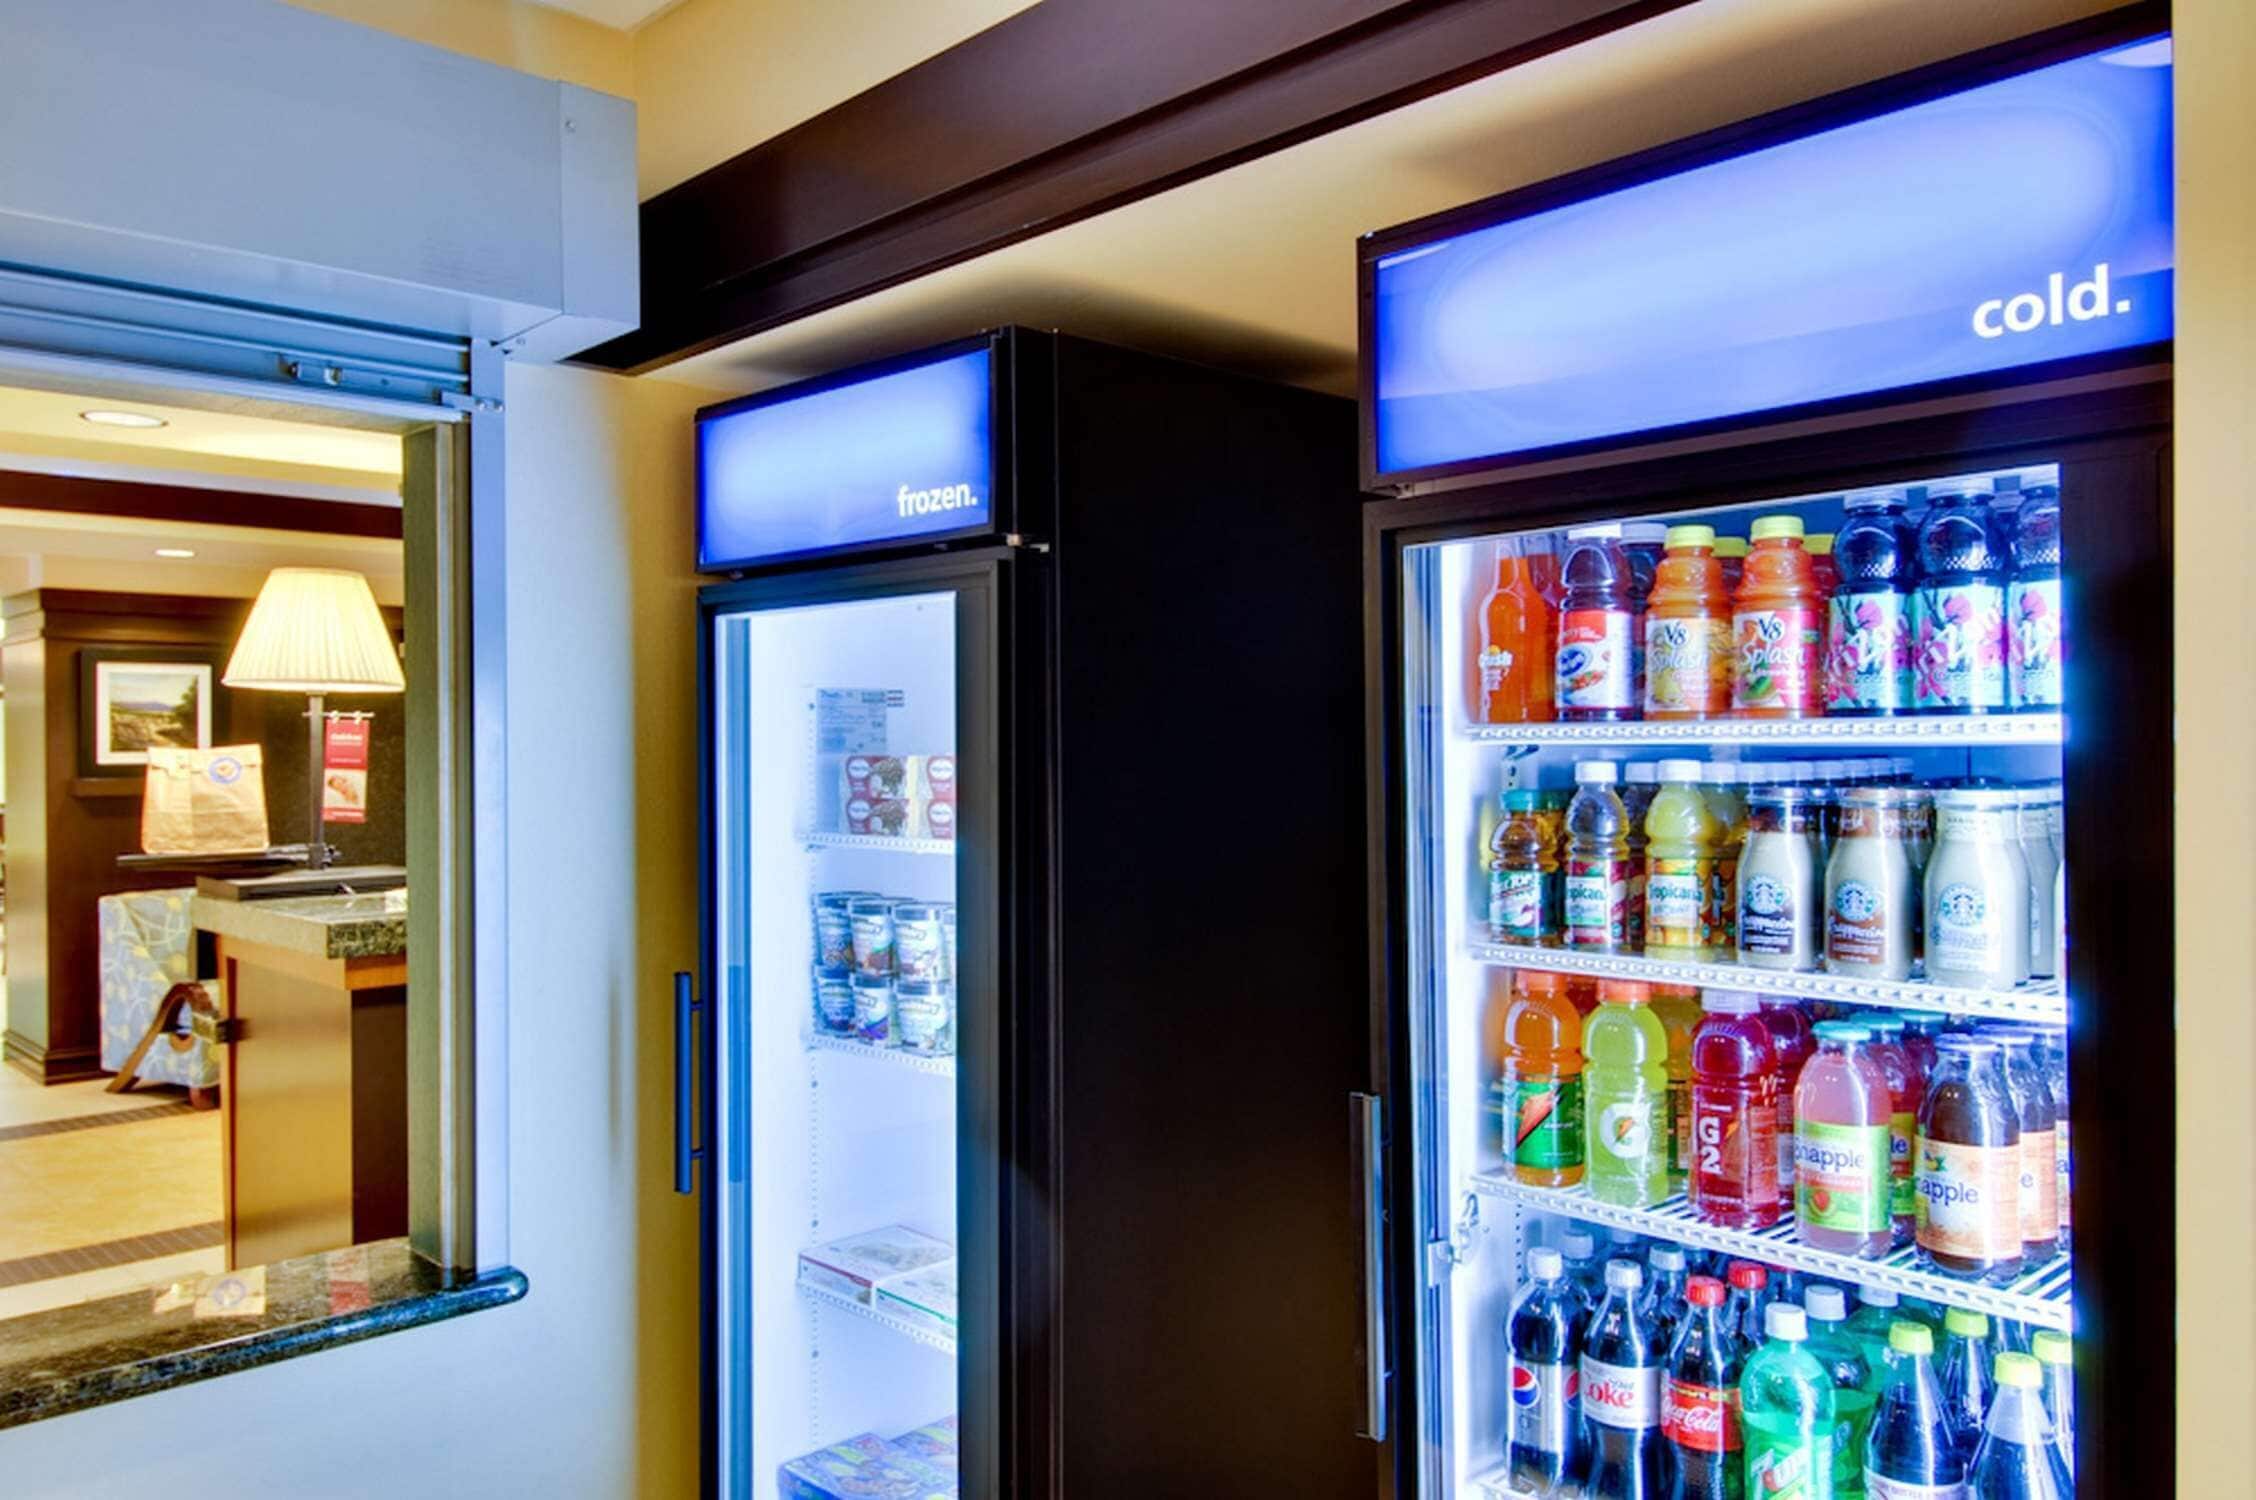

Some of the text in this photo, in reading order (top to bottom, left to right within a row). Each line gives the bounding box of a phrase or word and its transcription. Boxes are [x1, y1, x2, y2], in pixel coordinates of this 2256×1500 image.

[1973, 263, 2131, 338] cold.
[898, 484, 978, 517] frozen.
[1664, 622, 1687, 646] V8
[1759, 614, 1782, 640] V8
[1916, 1177, 1979, 1206] apple
[1585, 1379, 1634, 1409] oke
